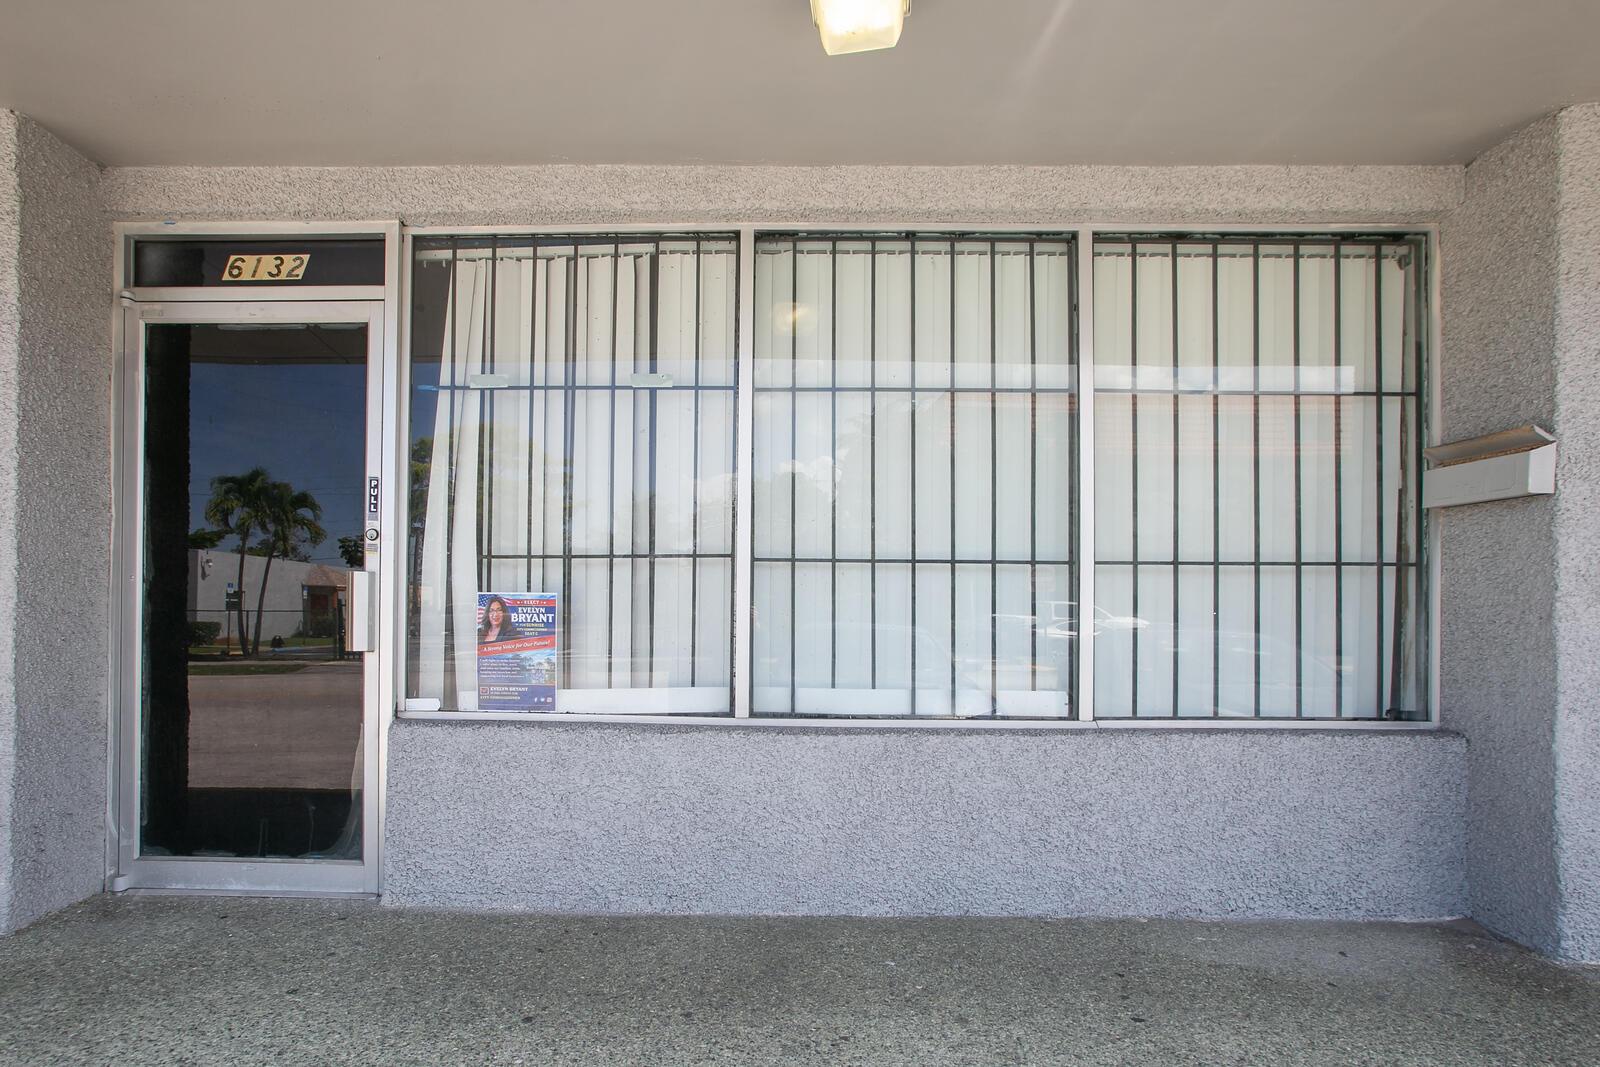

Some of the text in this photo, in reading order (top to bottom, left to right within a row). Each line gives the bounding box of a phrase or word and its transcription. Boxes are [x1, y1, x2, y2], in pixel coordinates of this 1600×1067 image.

[228, 256, 304, 279] 6132
[370, 480, 378, 512] PULL
[511, 613, 554, 623] BRYANT
